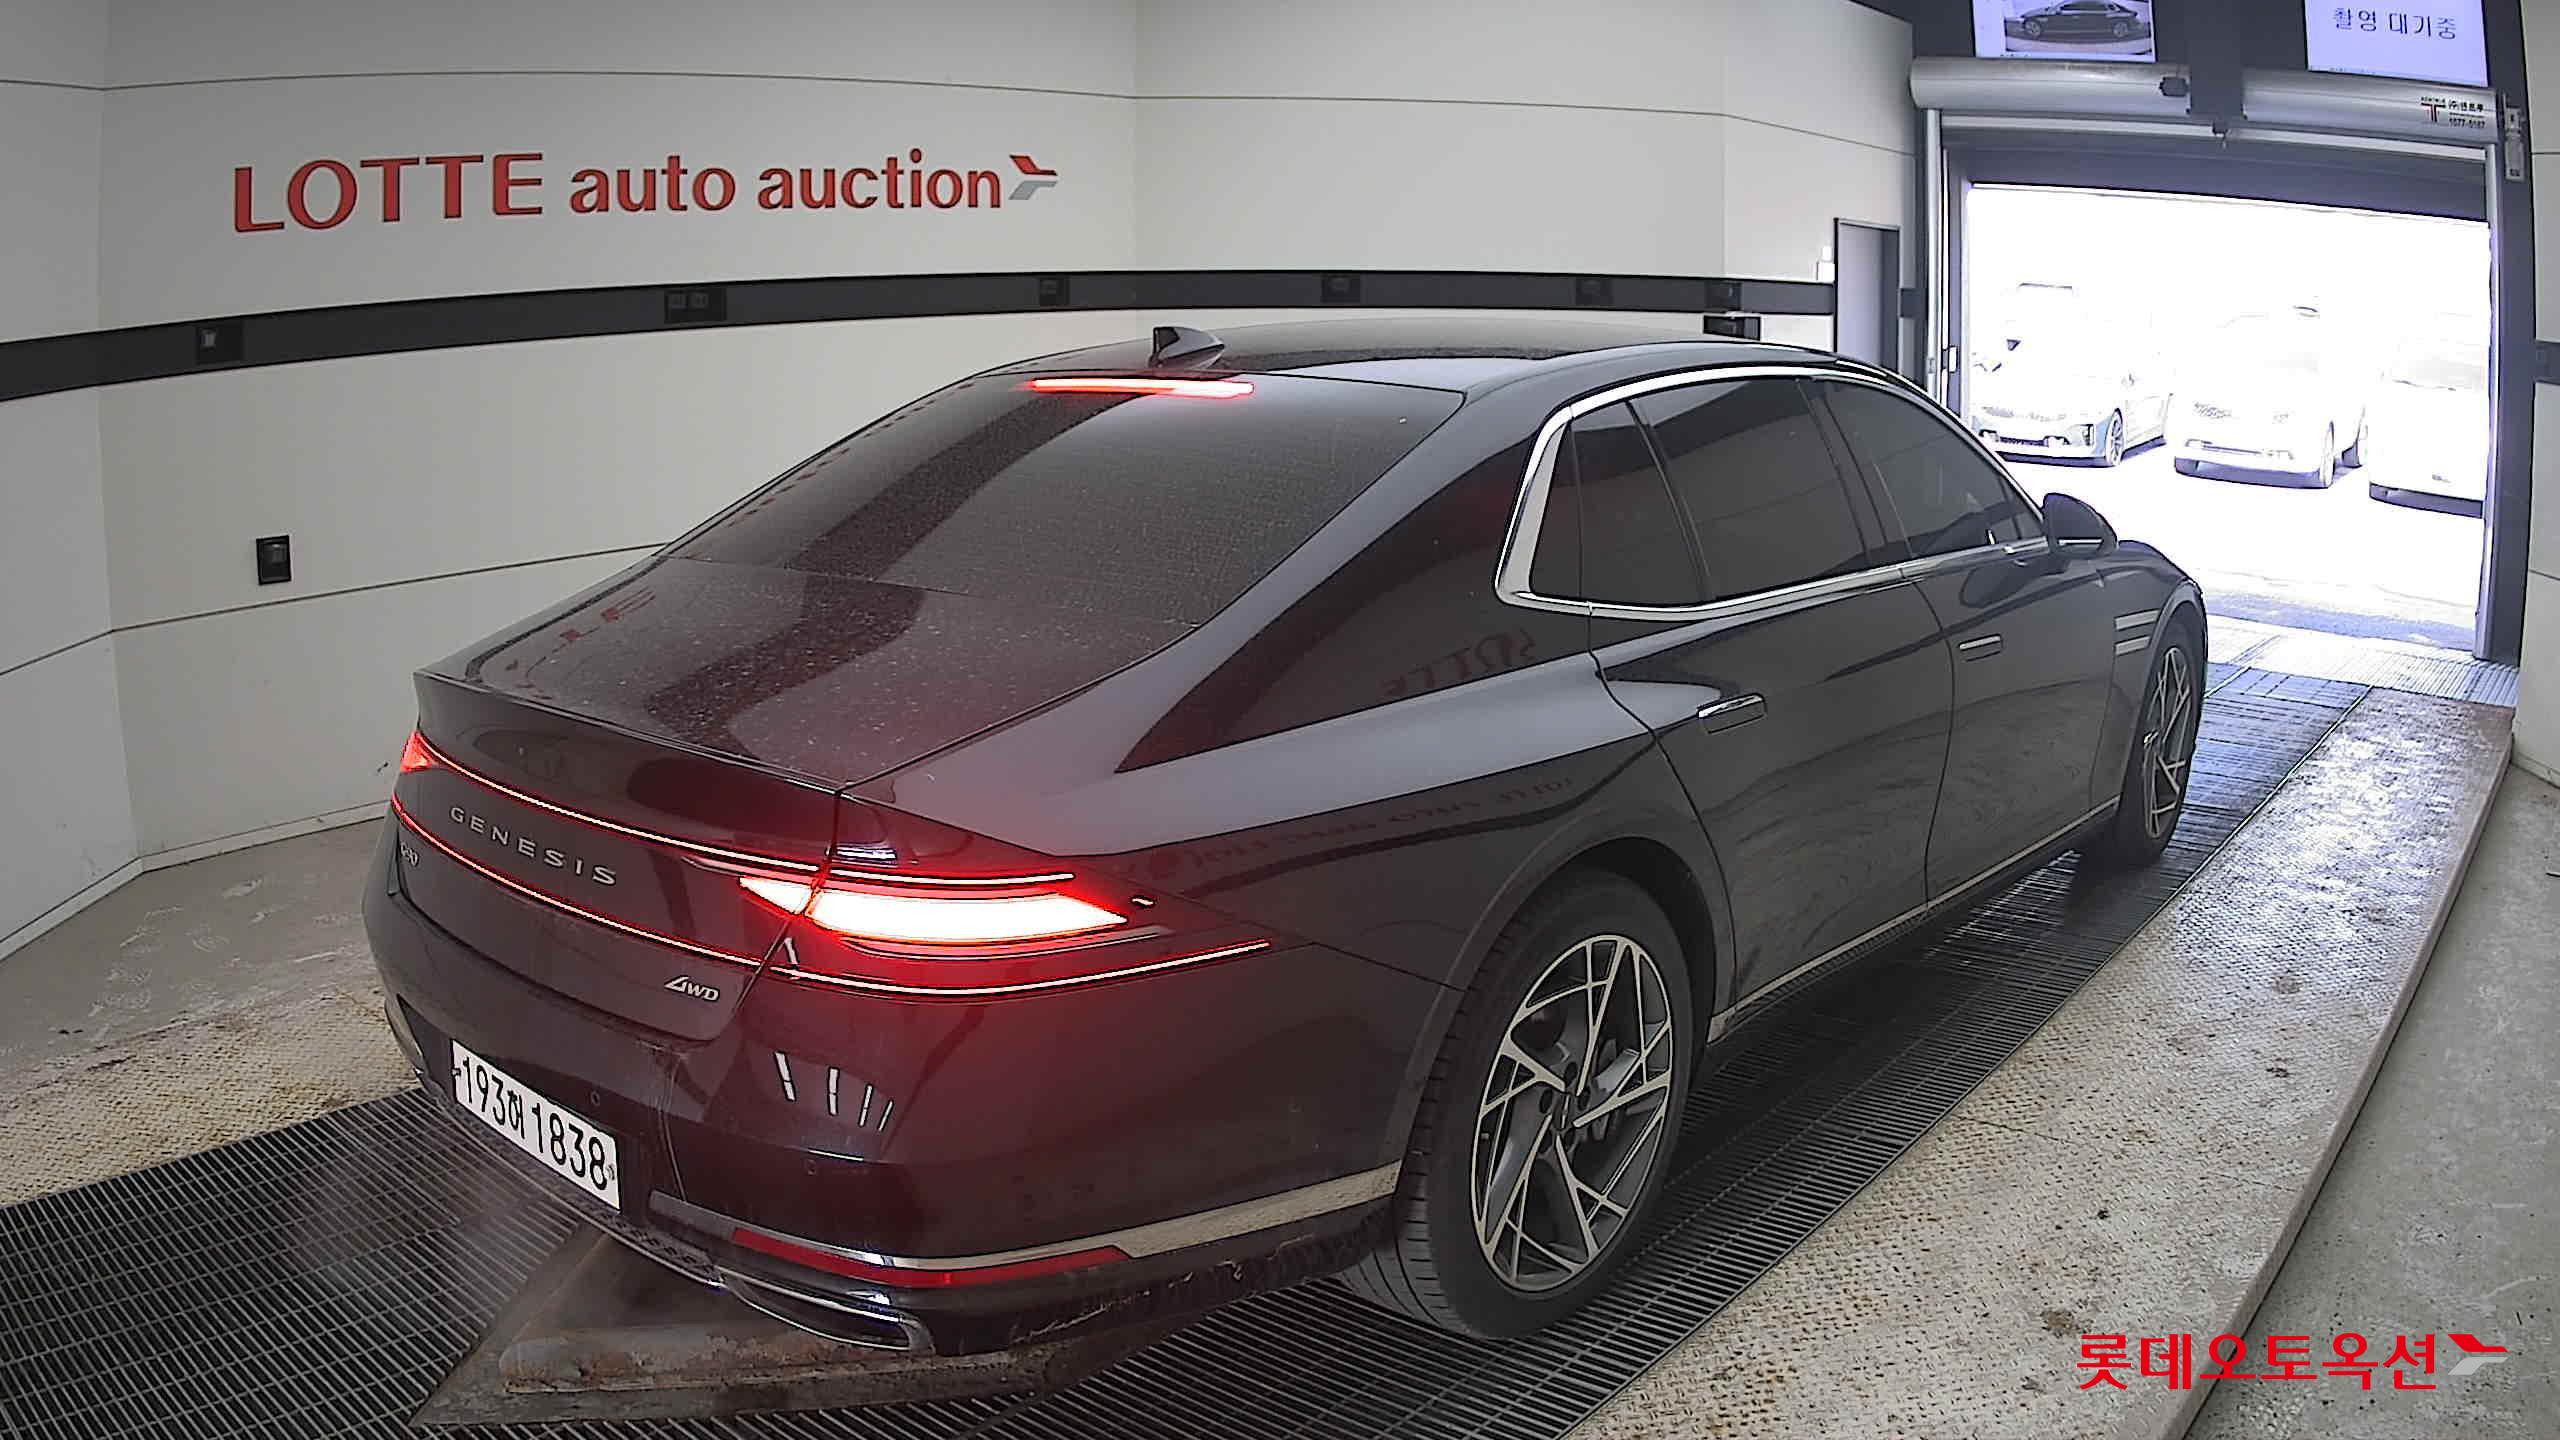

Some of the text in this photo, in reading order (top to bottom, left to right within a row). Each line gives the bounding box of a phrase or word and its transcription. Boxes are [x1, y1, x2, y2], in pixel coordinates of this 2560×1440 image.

[2389, 12, 2457, 40] 대기중
[234, 147, 1002, 233] LOTTE auto auction
[450, 807, 617, 885] GENESIS
[664, 975, 720, 1002] 4WD
